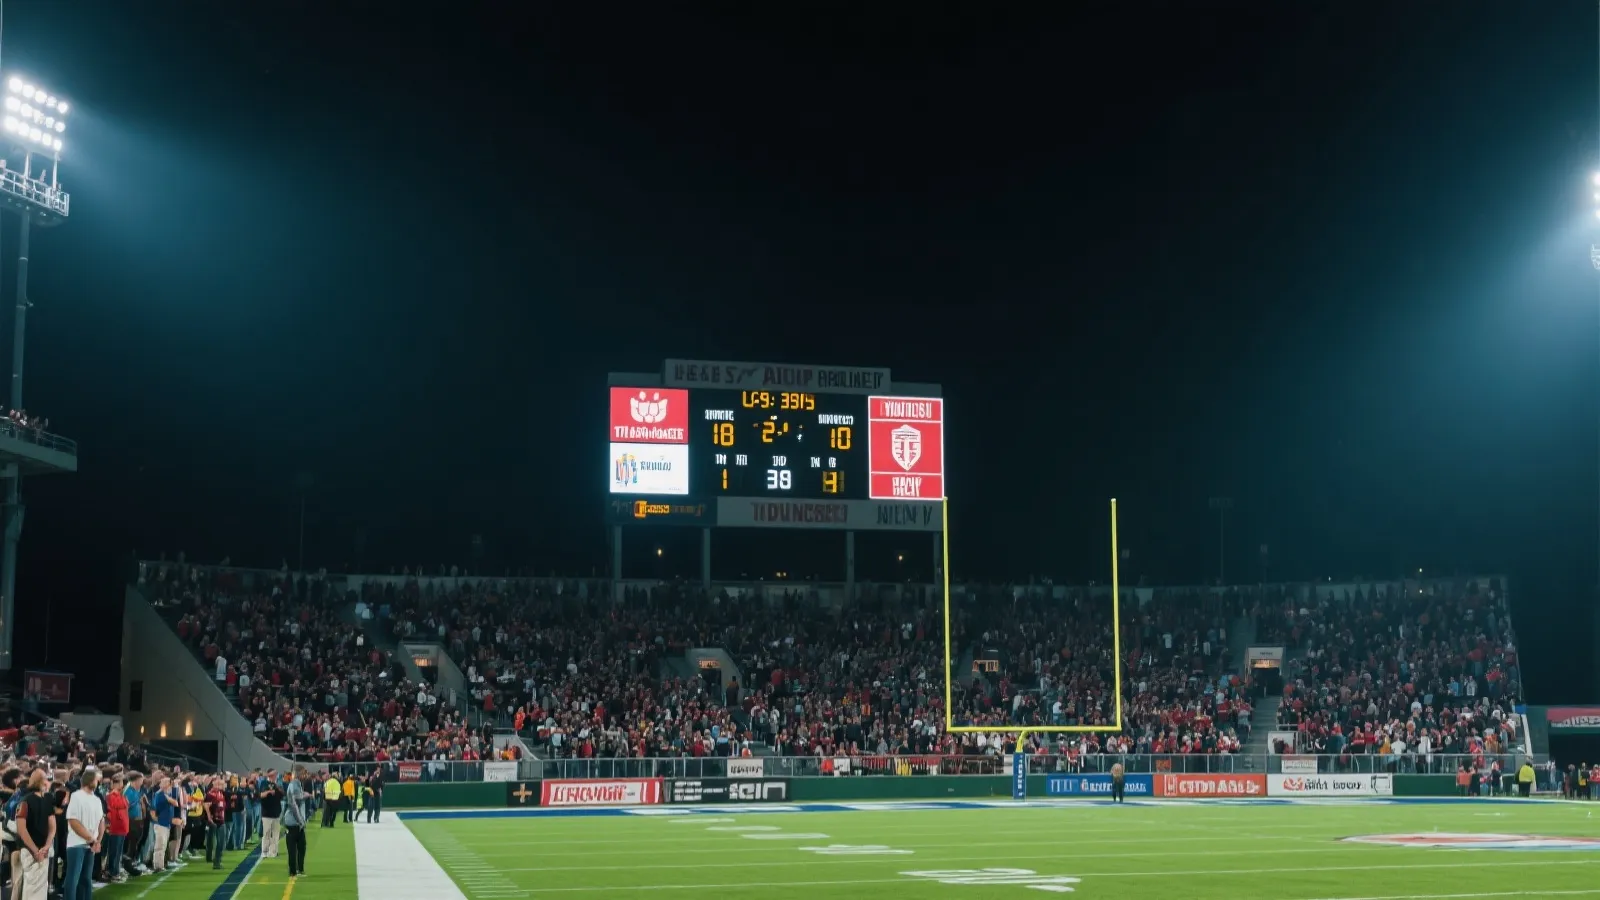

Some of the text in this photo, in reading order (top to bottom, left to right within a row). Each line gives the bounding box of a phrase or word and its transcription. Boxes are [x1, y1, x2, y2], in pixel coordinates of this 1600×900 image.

[713, 423, 734, 446] 18
[831, 426, 851, 450] 10
[722, 468, 728, 490] 1
[767, 469, 792, 490] 38
